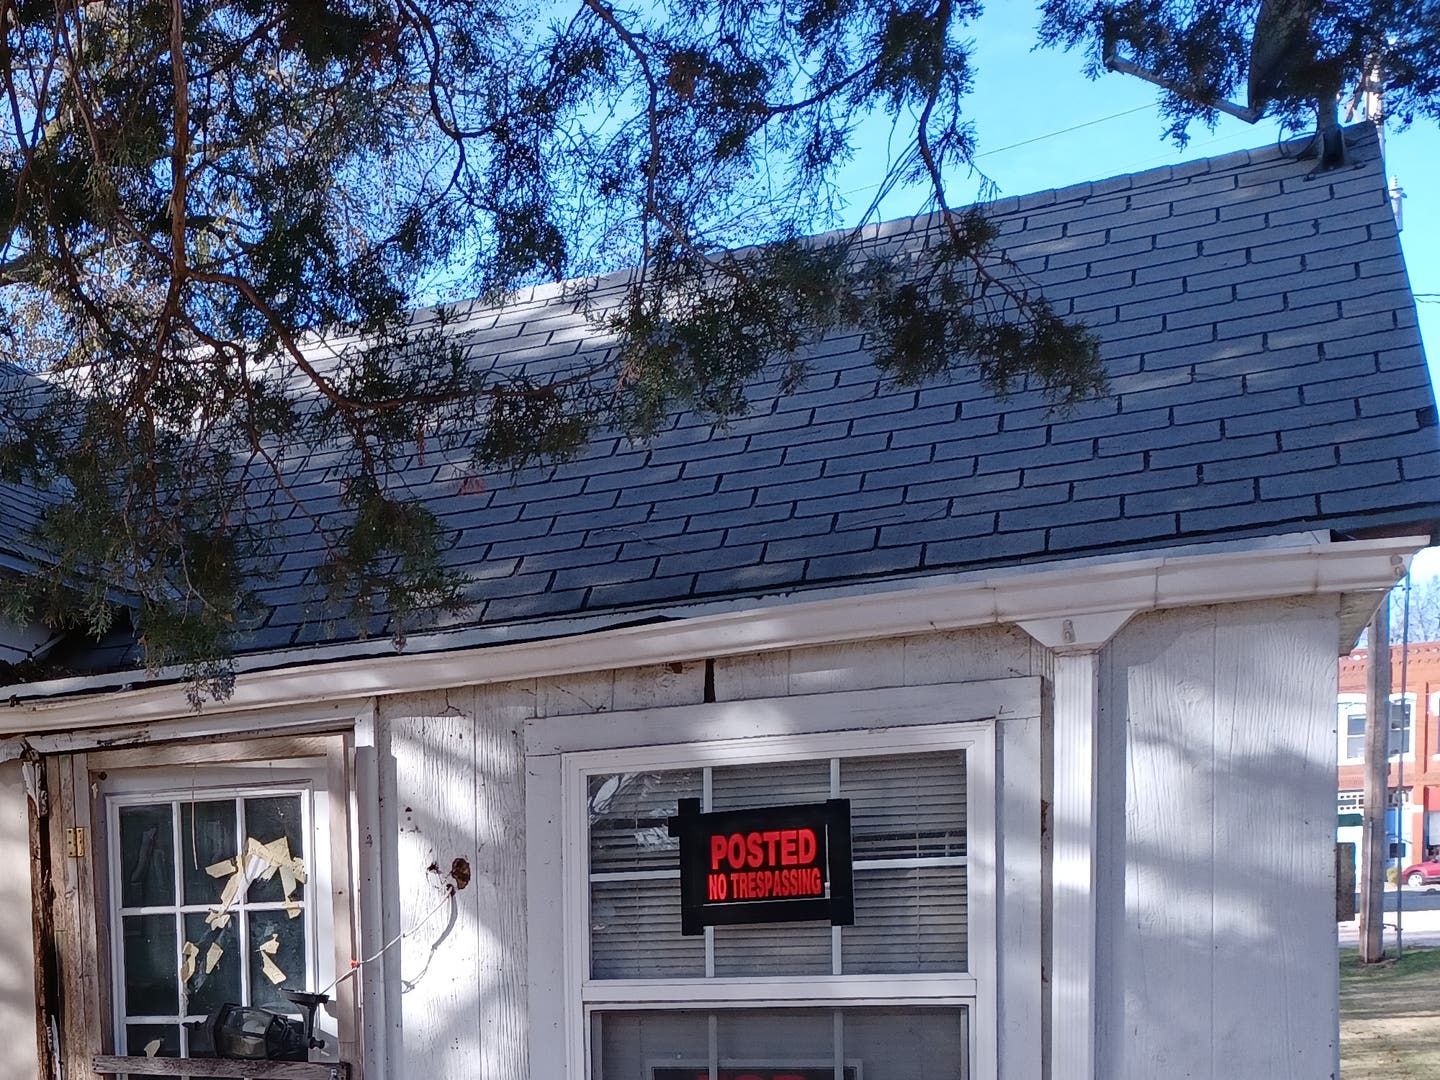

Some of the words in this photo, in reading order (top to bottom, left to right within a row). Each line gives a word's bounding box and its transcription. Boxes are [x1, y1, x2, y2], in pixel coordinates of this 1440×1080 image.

[710, 828, 817, 870] POSTED
[708, 873, 727, 900] NO
[730, 867, 822, 899] TRESPASSING
